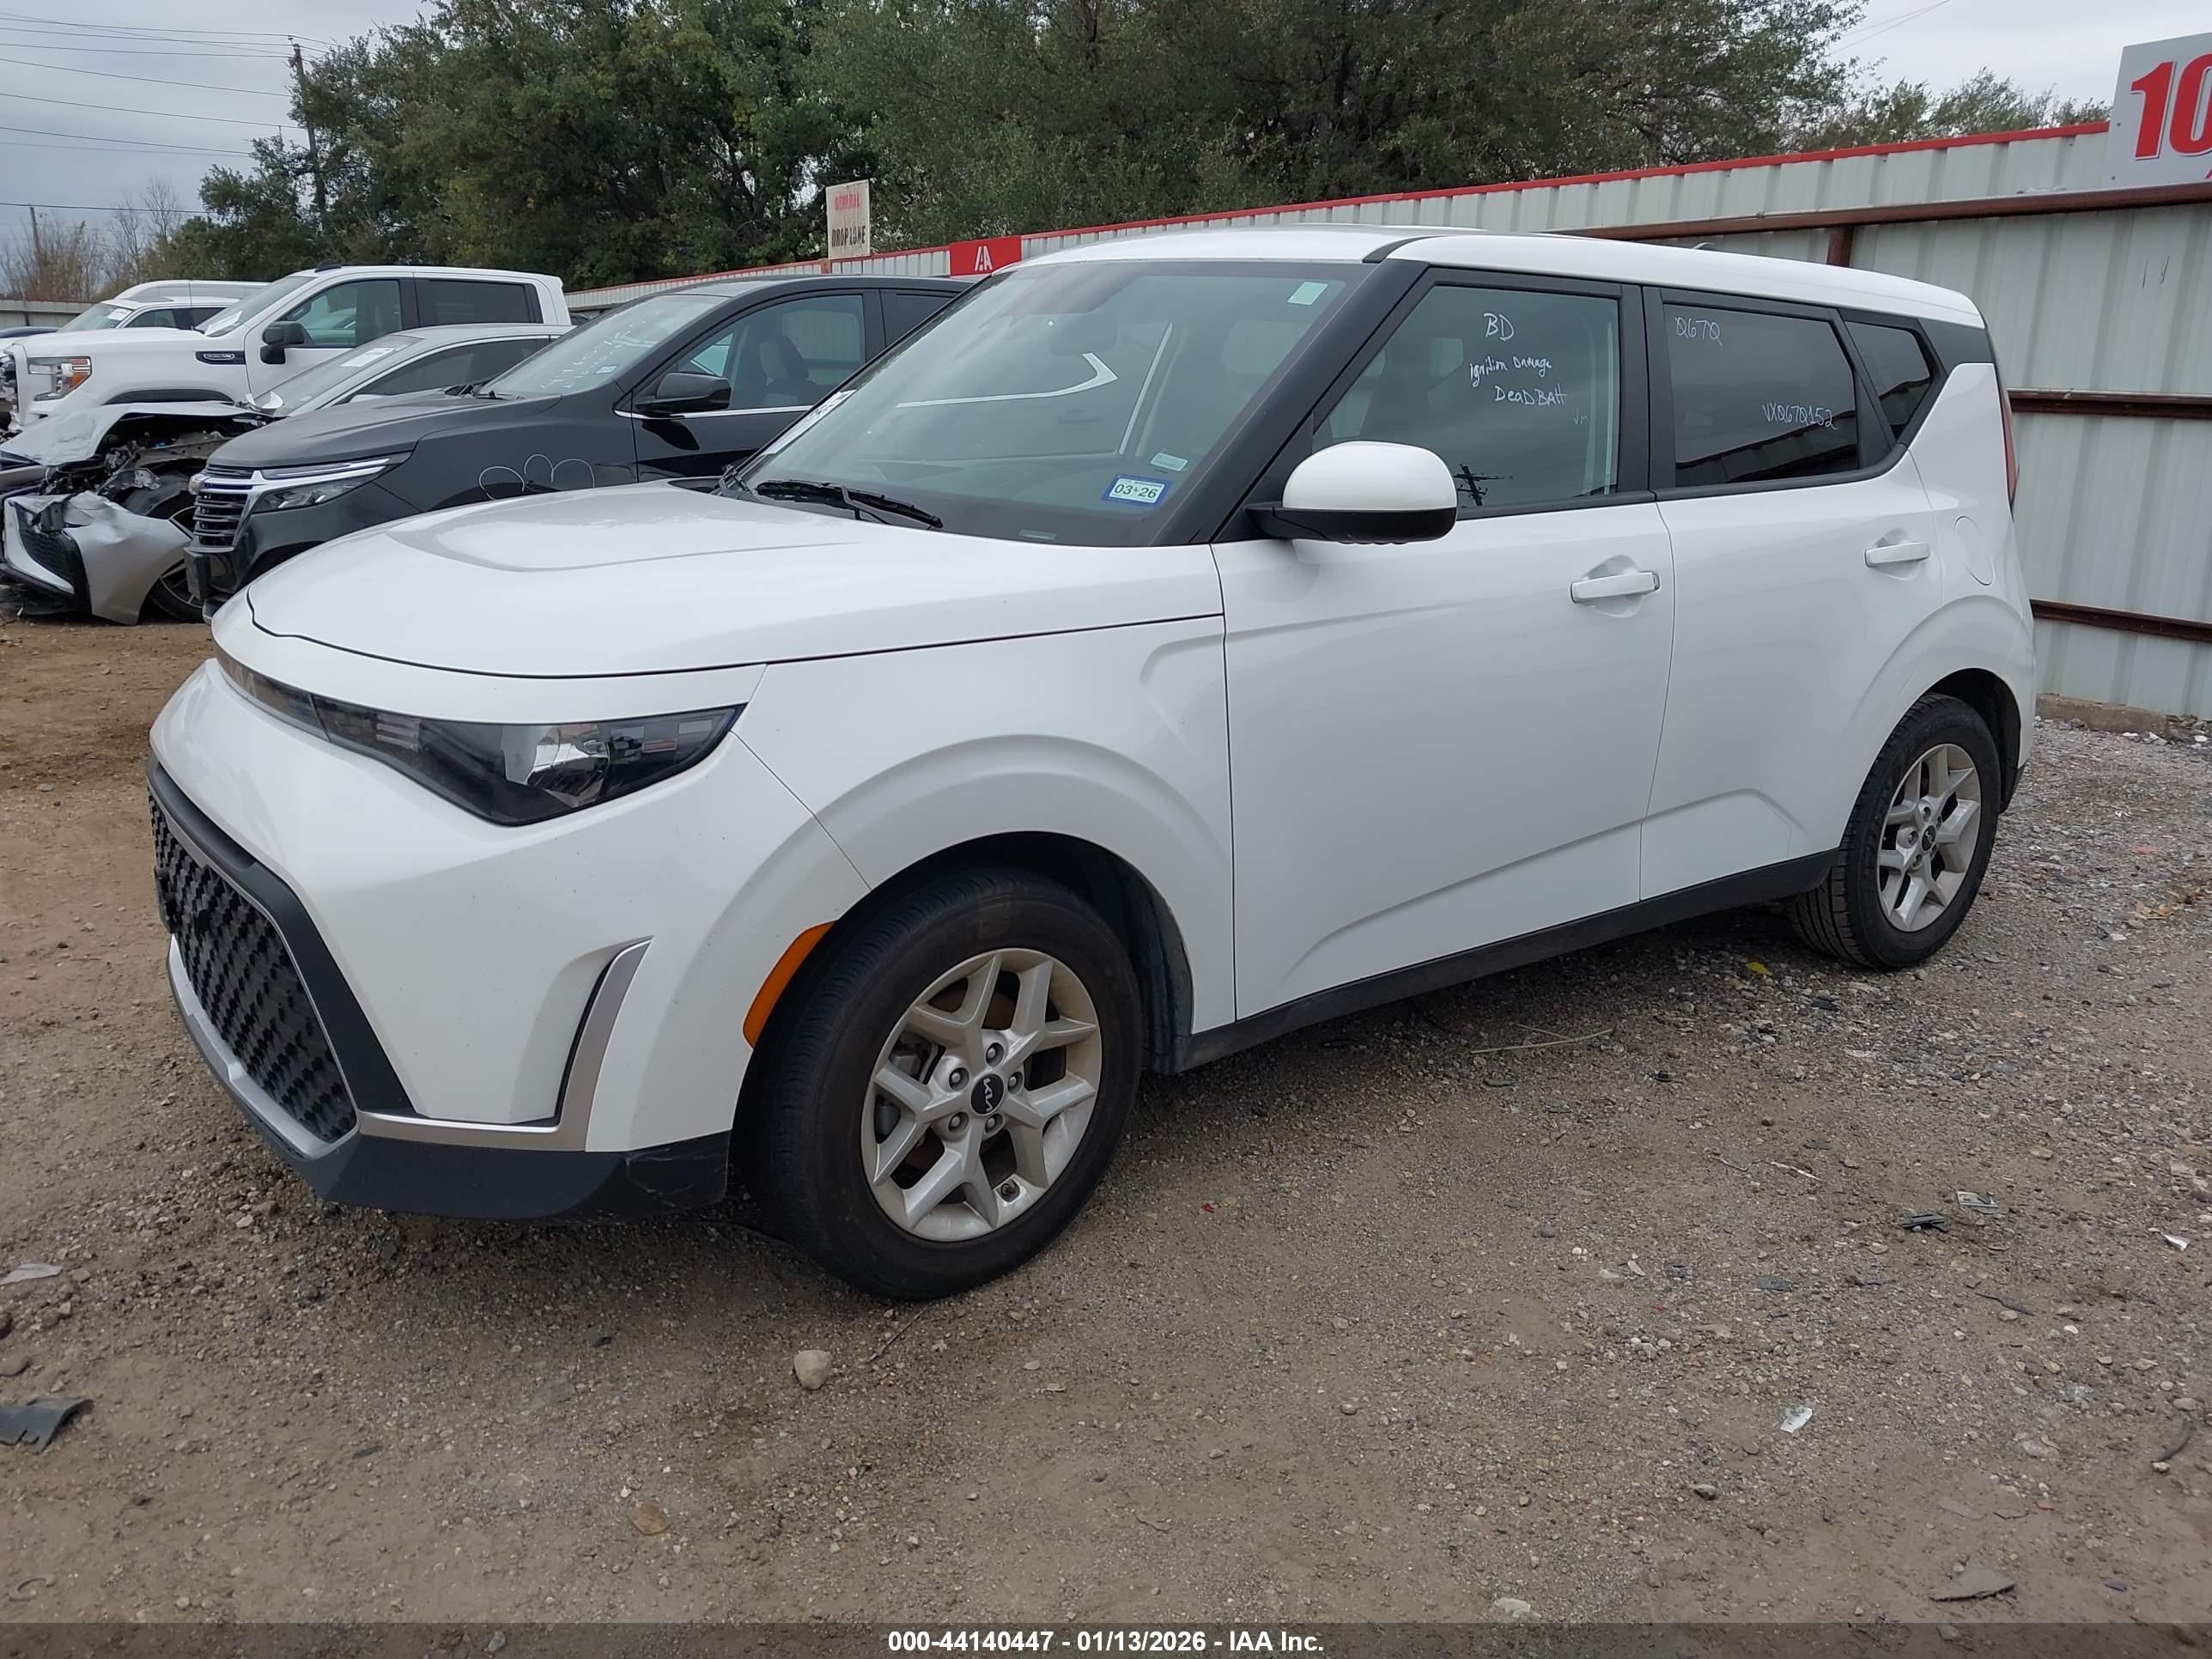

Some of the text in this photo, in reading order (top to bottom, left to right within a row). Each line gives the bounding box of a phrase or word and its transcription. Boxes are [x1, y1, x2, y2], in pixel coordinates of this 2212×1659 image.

[831, 227, 848, 247] DROP
[1484, 313, 1515, 341] BD
[1114, 483, 1133, 495] 03
[1138, 487, 1158, 499] 26
